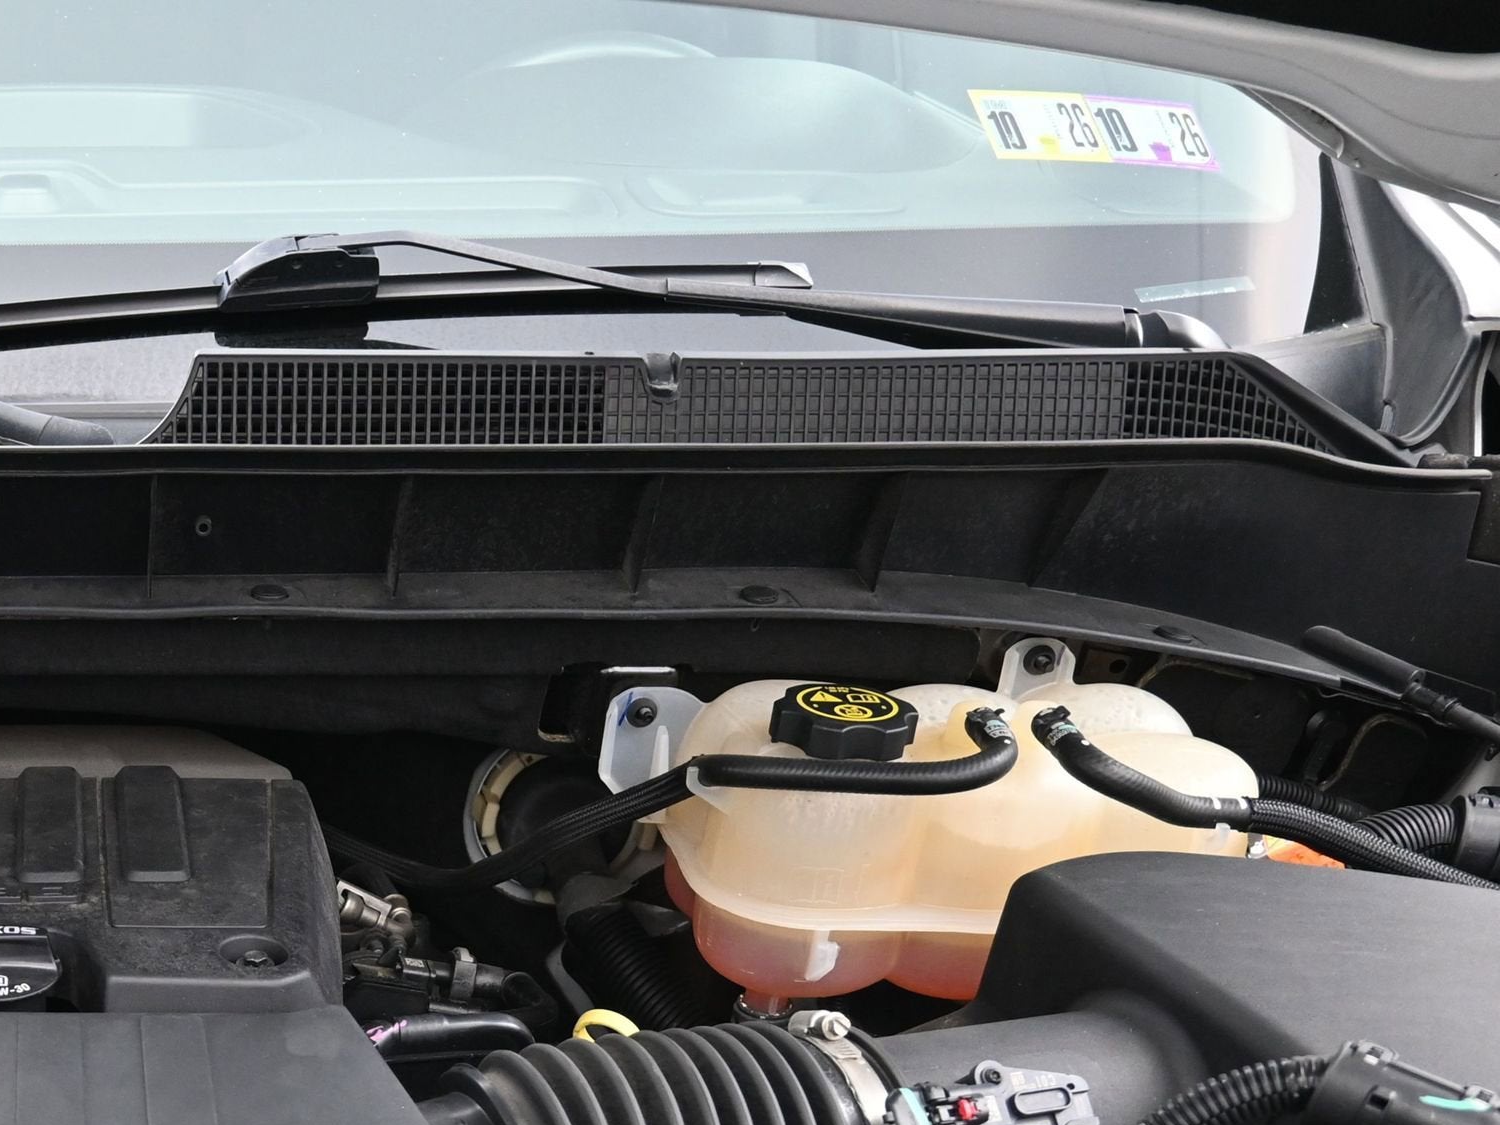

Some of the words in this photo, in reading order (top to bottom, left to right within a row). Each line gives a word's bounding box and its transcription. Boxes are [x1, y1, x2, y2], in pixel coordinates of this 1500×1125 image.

[988, 110, 1027, 150] 10
[1057, 102, 1099, 148] 26
[1094, 107, 1138, 152] 10
[1168, 111, 1209, 157] 26
